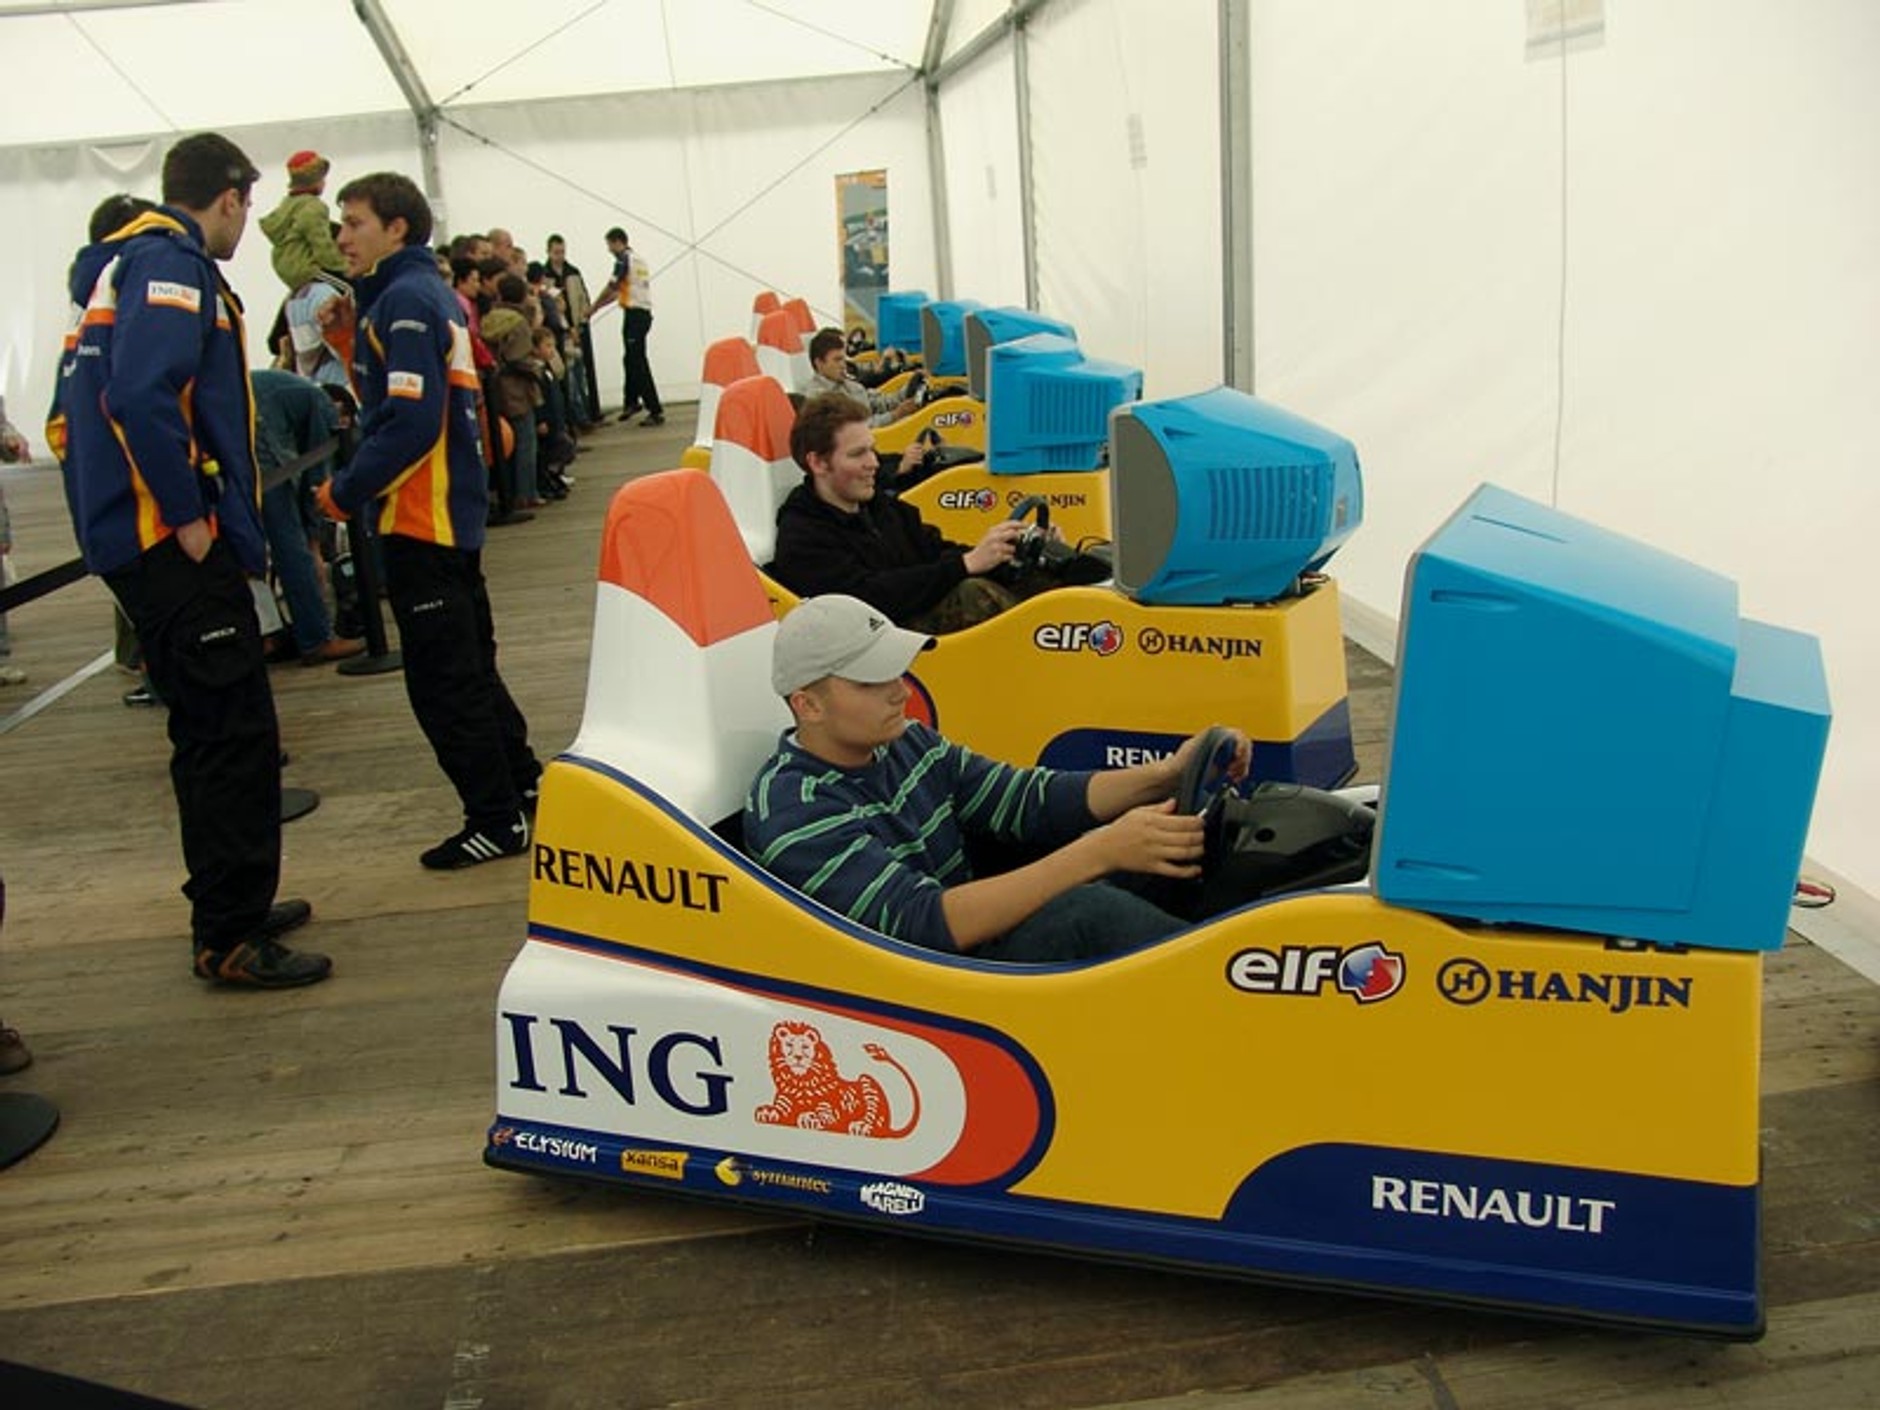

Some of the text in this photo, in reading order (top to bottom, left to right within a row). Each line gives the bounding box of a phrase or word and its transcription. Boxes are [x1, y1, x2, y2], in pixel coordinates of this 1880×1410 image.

[934, 412, 960, 427] elf
[939, 490, 977, 509] elf
[1035, 623, 1091, 652] elf
[1168, 634, 1263, 660] HANJIN
[534, 843, 730, 914] RENAULT
[1226, 946, 1341, 996] elf
[1496, 969, 1693, 1014] HANJIN
[501, 1011, 735, 1117] ING
[514, 1131, 598, 1164] ELYSIUM
[625, 1151, 679, 1171] xansa
[751, 1169, 832, 1194] symantec
[1372, 1175, 1616, 1234] RENAULT
